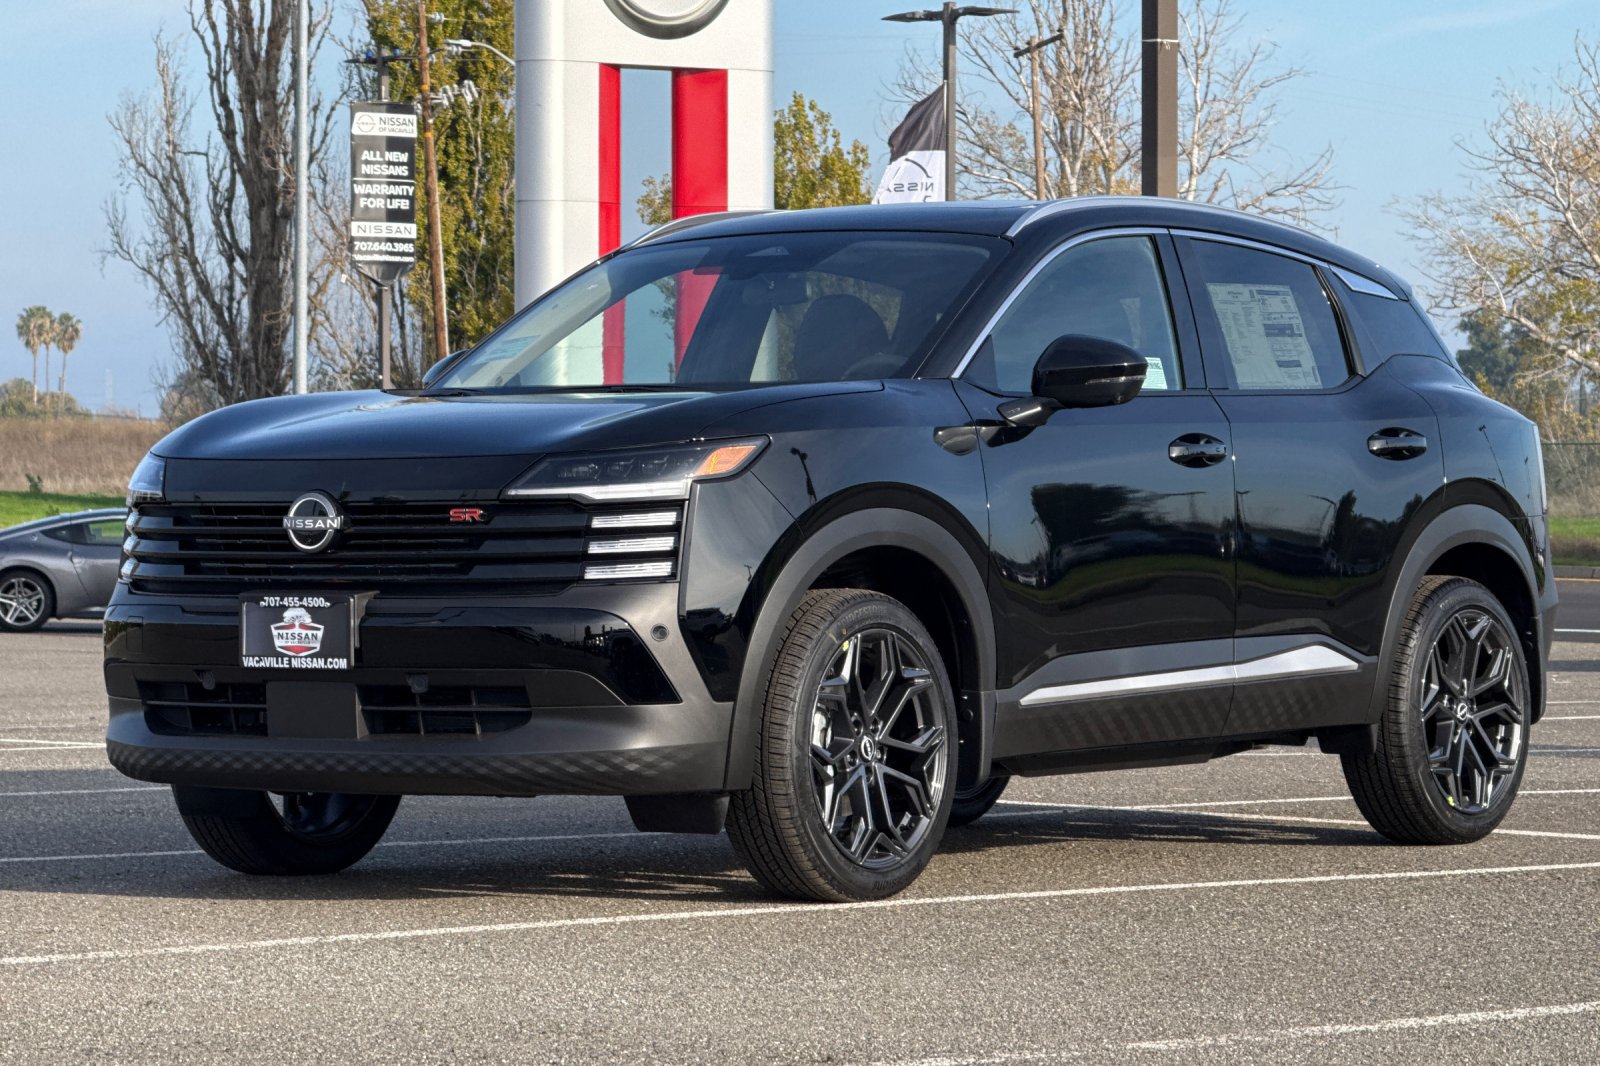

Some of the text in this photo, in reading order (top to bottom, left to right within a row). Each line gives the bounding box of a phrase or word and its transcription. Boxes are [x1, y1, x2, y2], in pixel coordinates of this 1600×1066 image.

[379, 117, 414, 127] NISSAN
[361, 150, 409, 162] ALL NEW
[361, 163, 409, 176] NISSANS
[353, 183, 415, 196] WARRANTY
[360, 197, 410, 209] FOR LIFE!
[357, 224, 412, 235] NISSAN
[353, 241, 415, 253] 707.640.3965
[450, 508, 480, 521] SR
[283, 518, 338, 529] NISSAN
[264, 596, 325, 608] 707-455-4500
[277, 632, 318, 641] NISSAN
[242, 656, 348, 670] VACAVILLE NISSAN.COM
